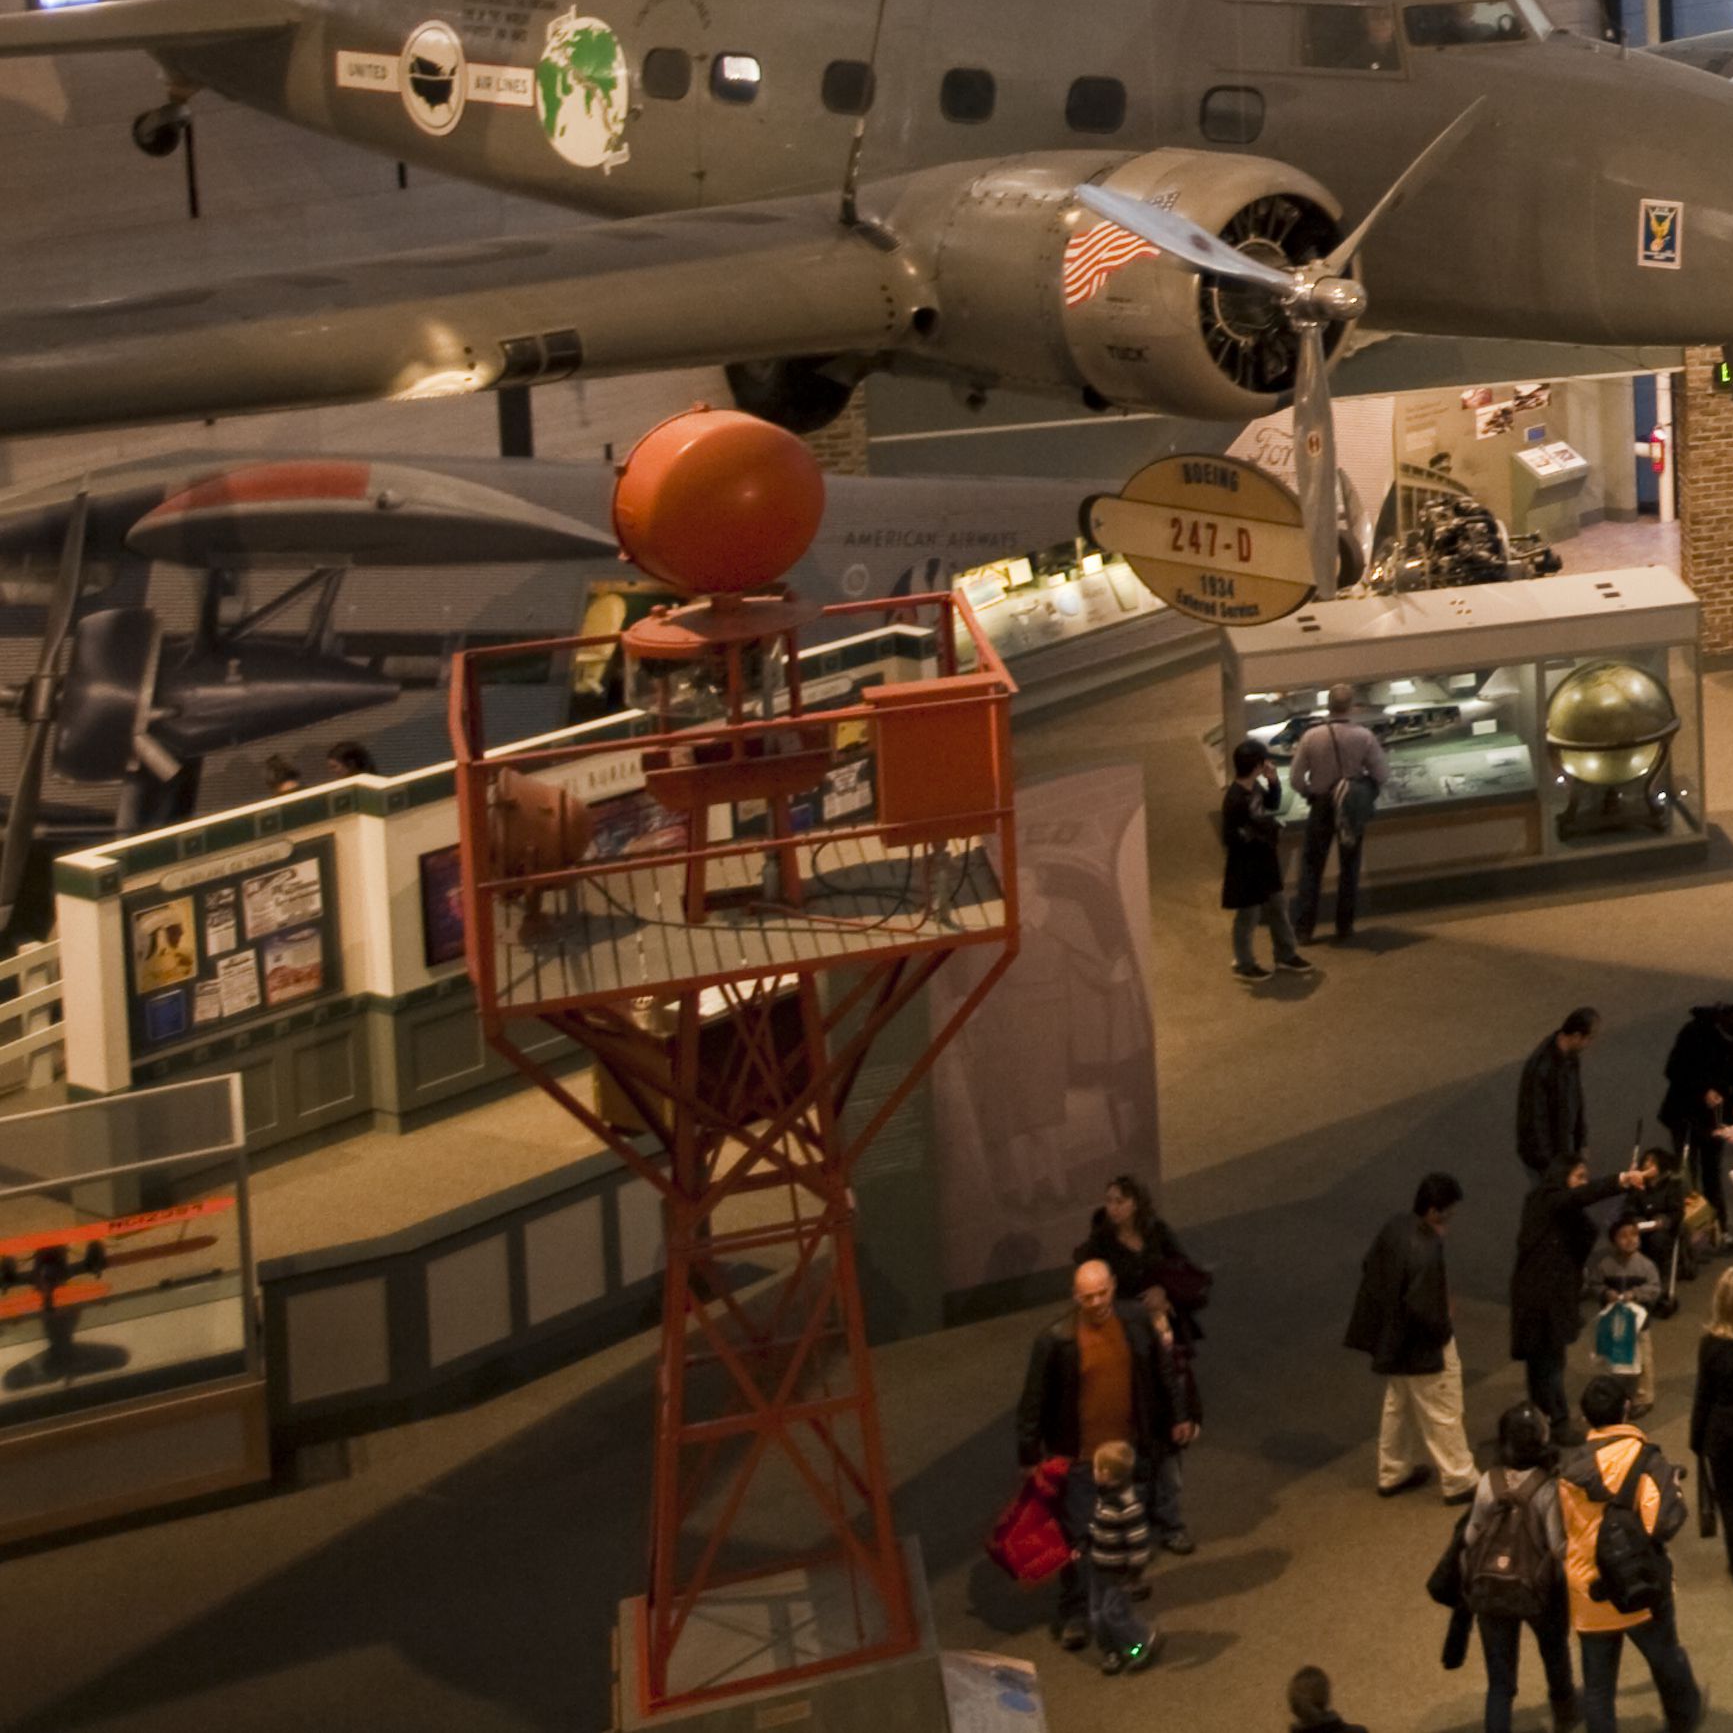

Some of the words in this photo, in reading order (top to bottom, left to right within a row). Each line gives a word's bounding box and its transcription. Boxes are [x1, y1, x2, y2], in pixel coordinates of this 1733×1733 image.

[349, 63, 387, 80] UNITED
[475, 75, 493, 91] AIR
[496, 77, 528, 95] LINES
[1249, 426, 1294, 466] For
[1182, 462, 1240, 493] BOEING
[844, 530, 937, 548] AMERICAN
[947, 530, 1019, 549] AIRWAYS
[1170, 517, 1252, 563] 247-D
[1200, 573, 1235, 598] 1934
[1174, 588, 1217, 617] Entered
[1219, 597, 1260, 620] Service
[588, 761, 640, 790] BUREA
